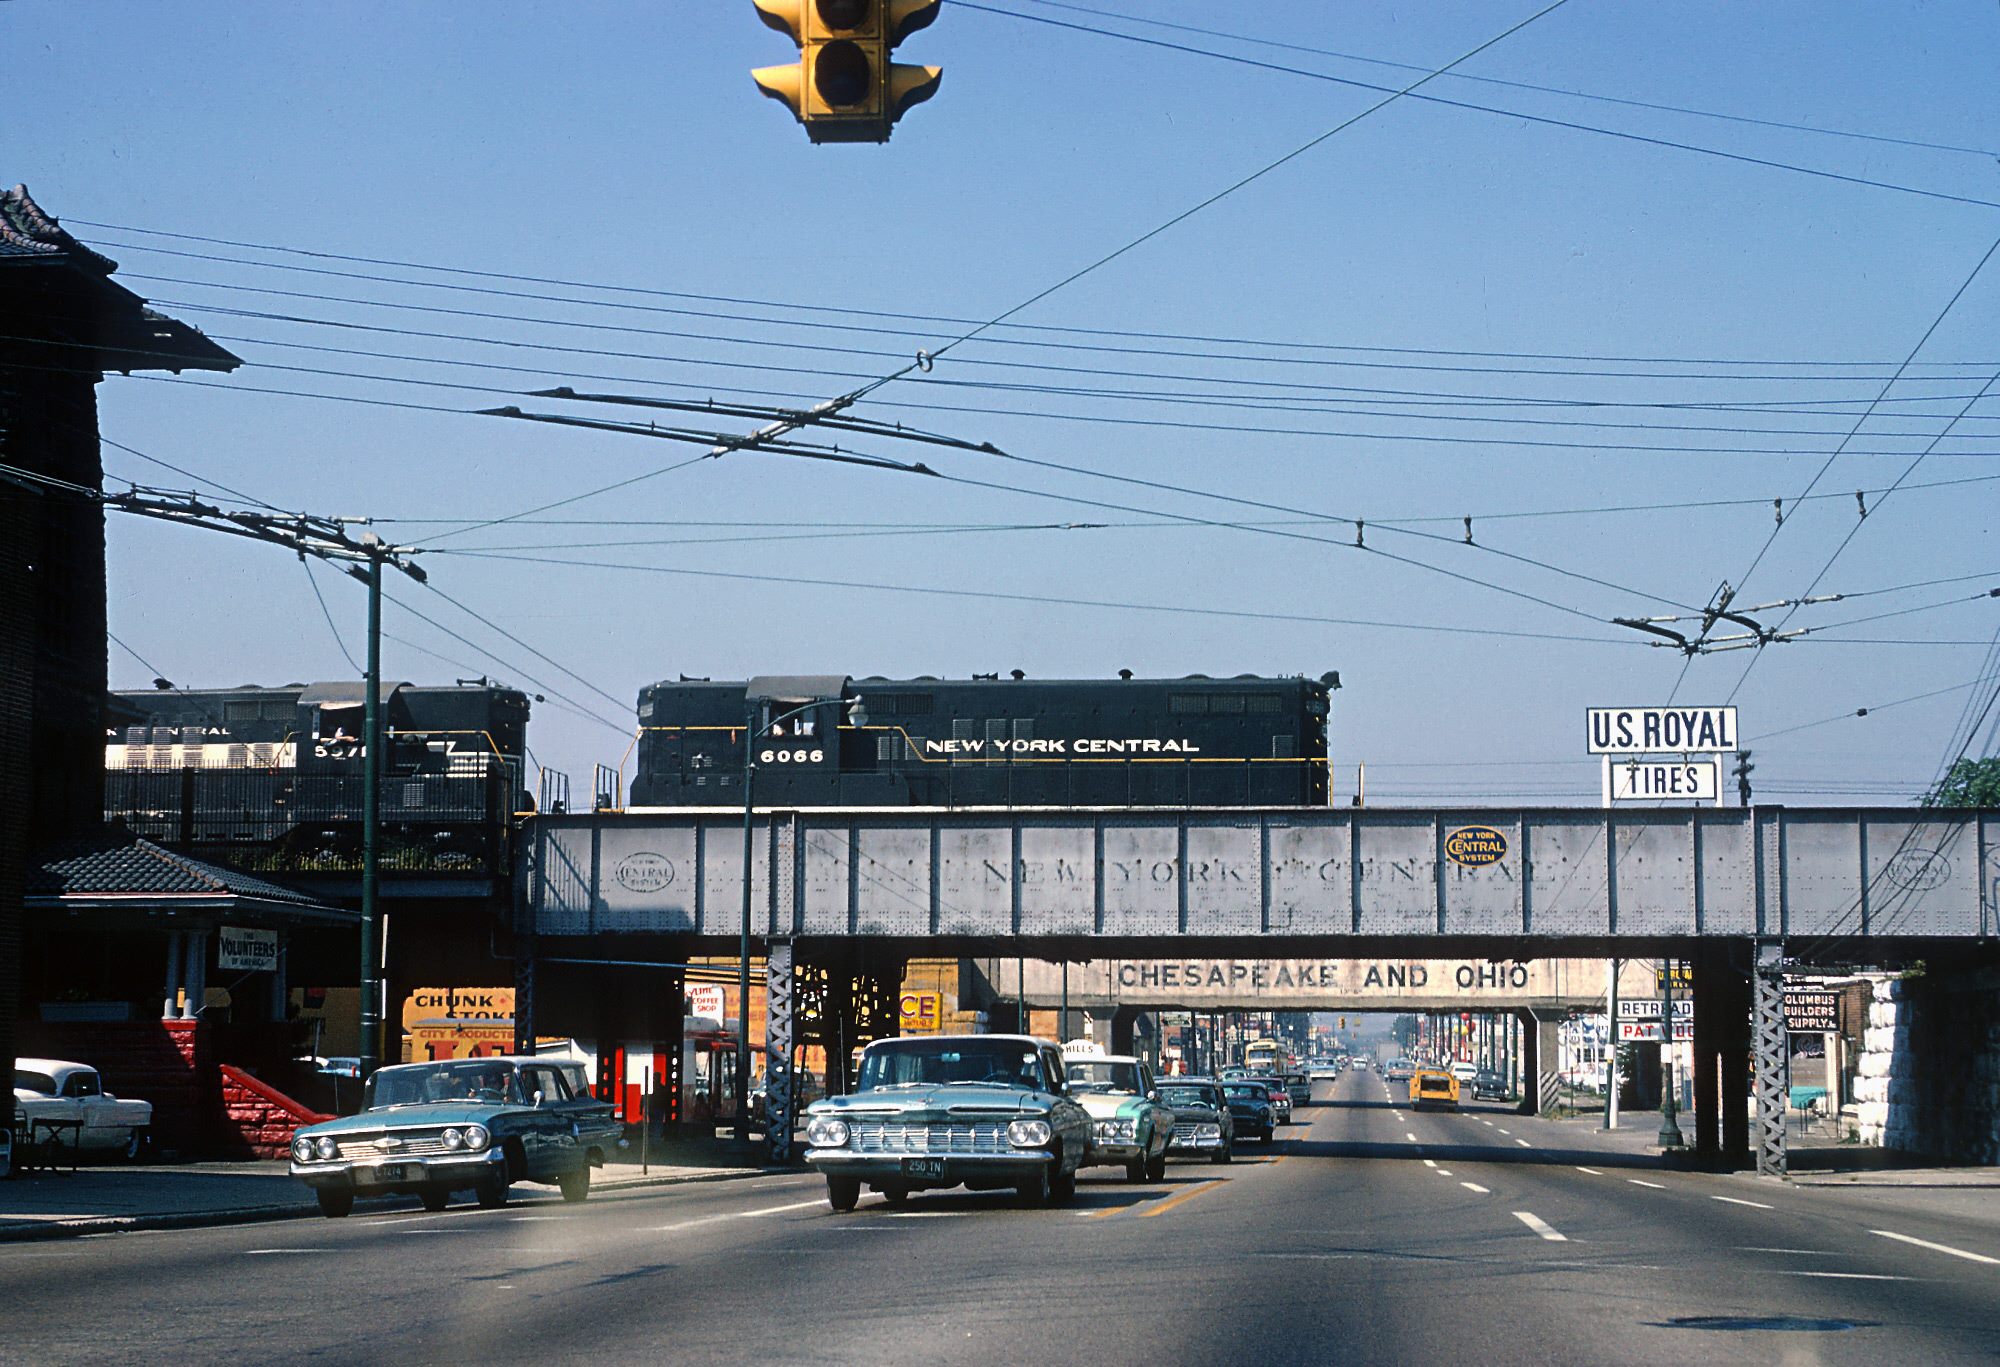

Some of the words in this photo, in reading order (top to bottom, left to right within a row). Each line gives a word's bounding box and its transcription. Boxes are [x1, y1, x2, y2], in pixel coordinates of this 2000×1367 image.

[1593, 711, 1638, 748] U.S.
[1643, 710, 1733, 748] ROYAL
[926, 739, 984, 753] NEW
[994, 739, 1066, 753] YORK
[1073, 739, 1200, 753] CENTRAL
[760, 750, 824, 763] 6066
[1626, 767, 1698, 794] TIRES
[1457, 831, 1474, 839] NEW
[1448, 838, 1505, 855] CENTRAL
[1459, 854, 1495, 862] SYSTEM
[984, 861, 1076, 883] NEW
[1112, 861, 1246, 883] YORK
[220, 937, 275, 957] VOLUNTEERS
[1119, 965, 1338, 987] CHESAPEAKE
[1364, 965, 1428, 988] AND
[1455, 965, 1528, 988] OHIO
[415, 995, 493, 1007] CHUNK
[692, 997, 719, 1005] COFFEE
[1784, 1006, 1835, 1016] BUILDERS
[1788, 1017, 1828, 1028] SUPPLY
[420, 1030, 446, 1039] CITY
[1624, 1025, 1654, 1038] PAT
